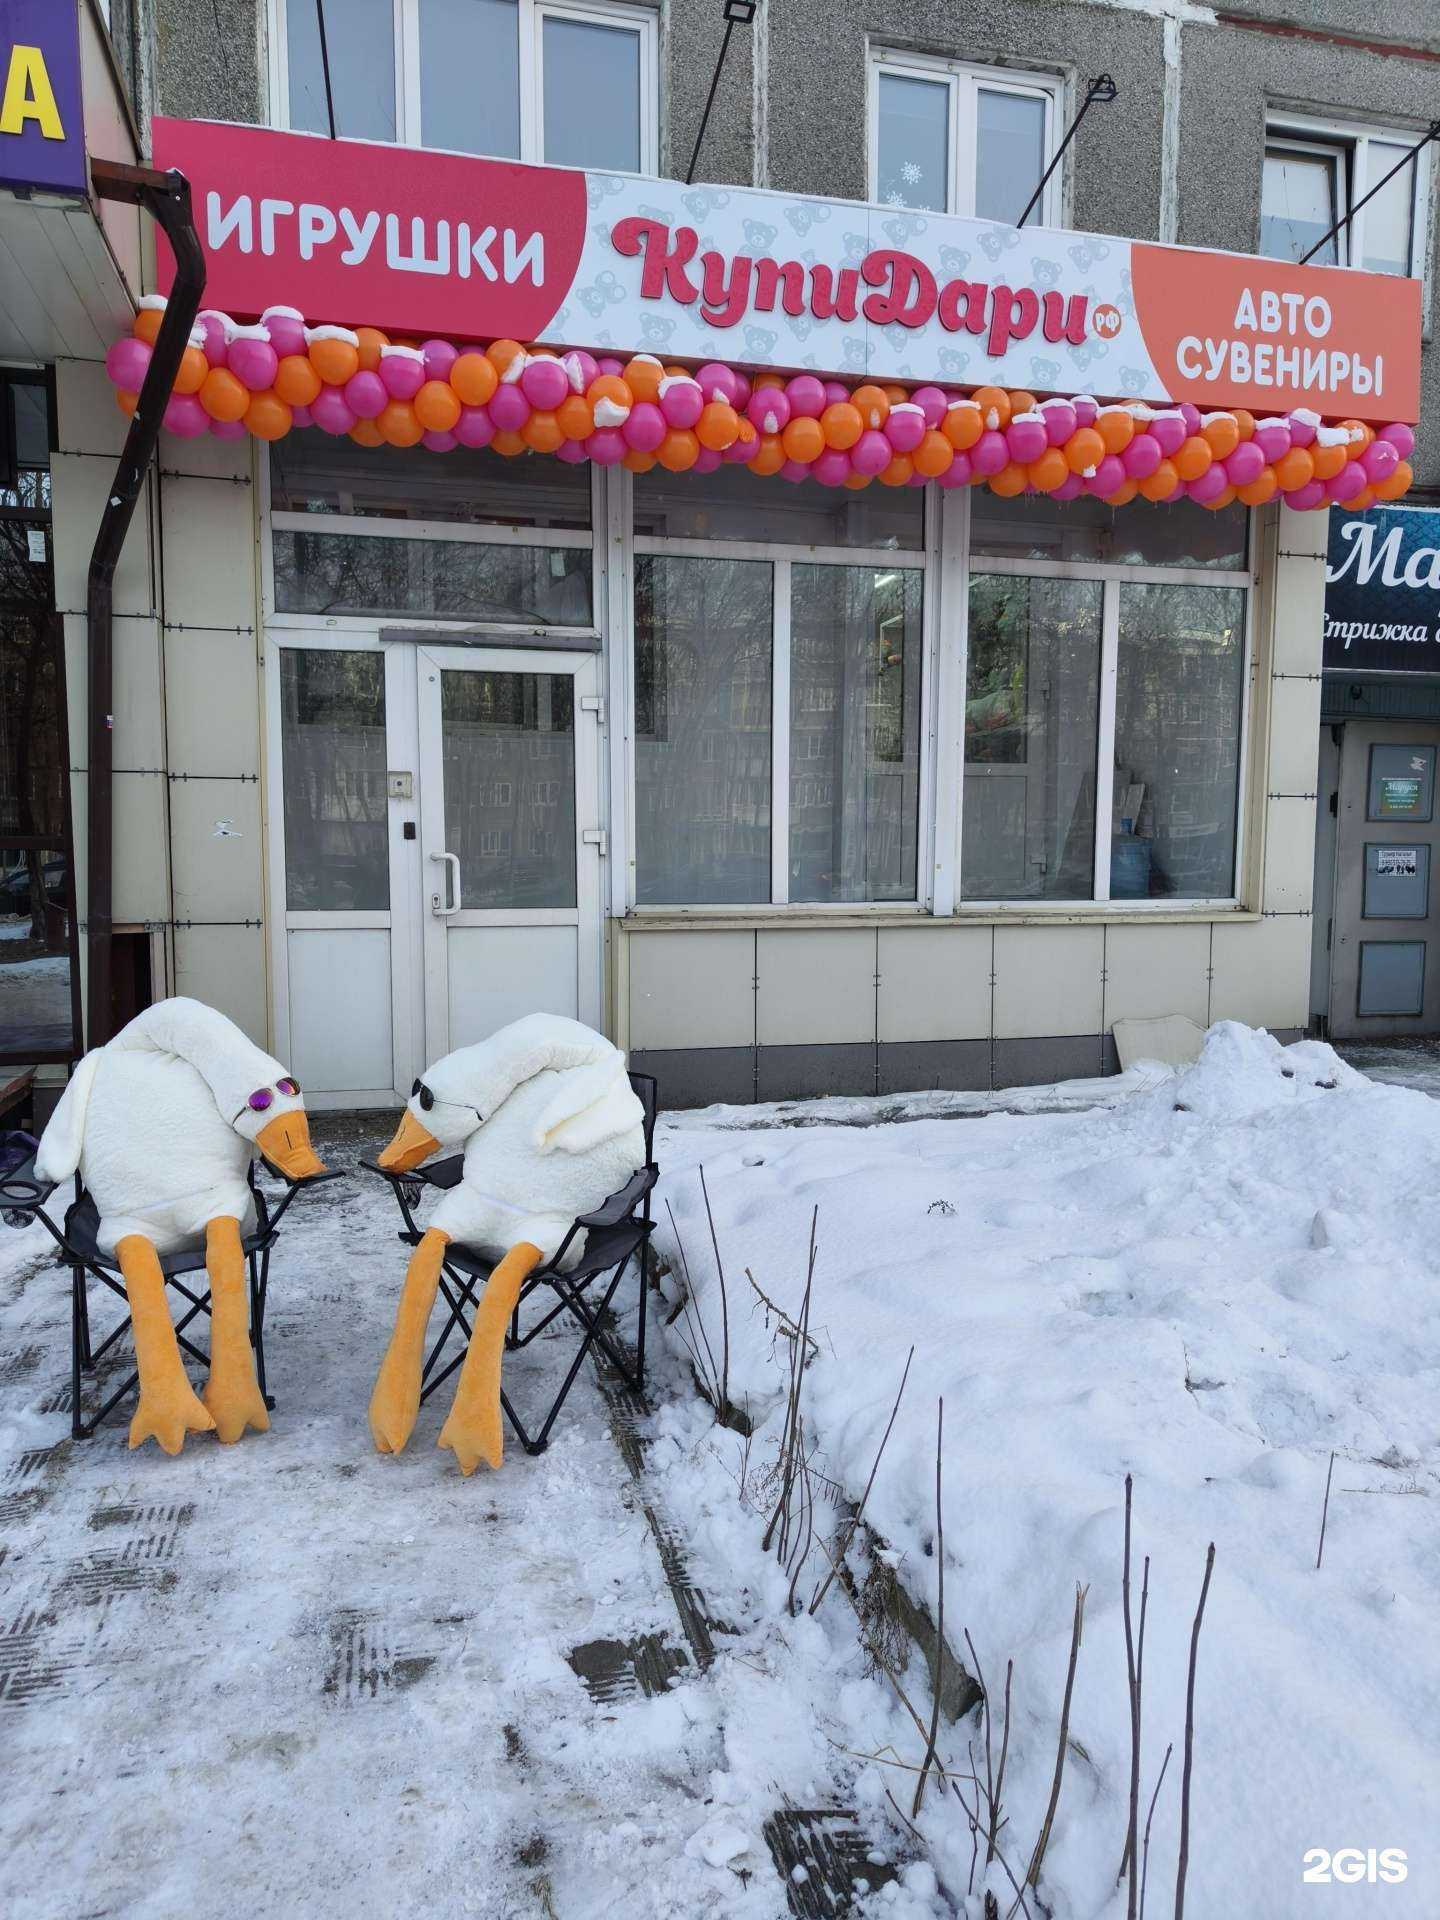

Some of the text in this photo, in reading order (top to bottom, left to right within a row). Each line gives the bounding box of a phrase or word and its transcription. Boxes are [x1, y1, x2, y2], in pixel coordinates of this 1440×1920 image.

[0, 44, 66, 141] А
[206, 190, 545, 287] ИГРУШКИ
[1234, 287, 1332, 338] АВТО
[1176, 335, 1384, 396] СУВЕНИРЫ
